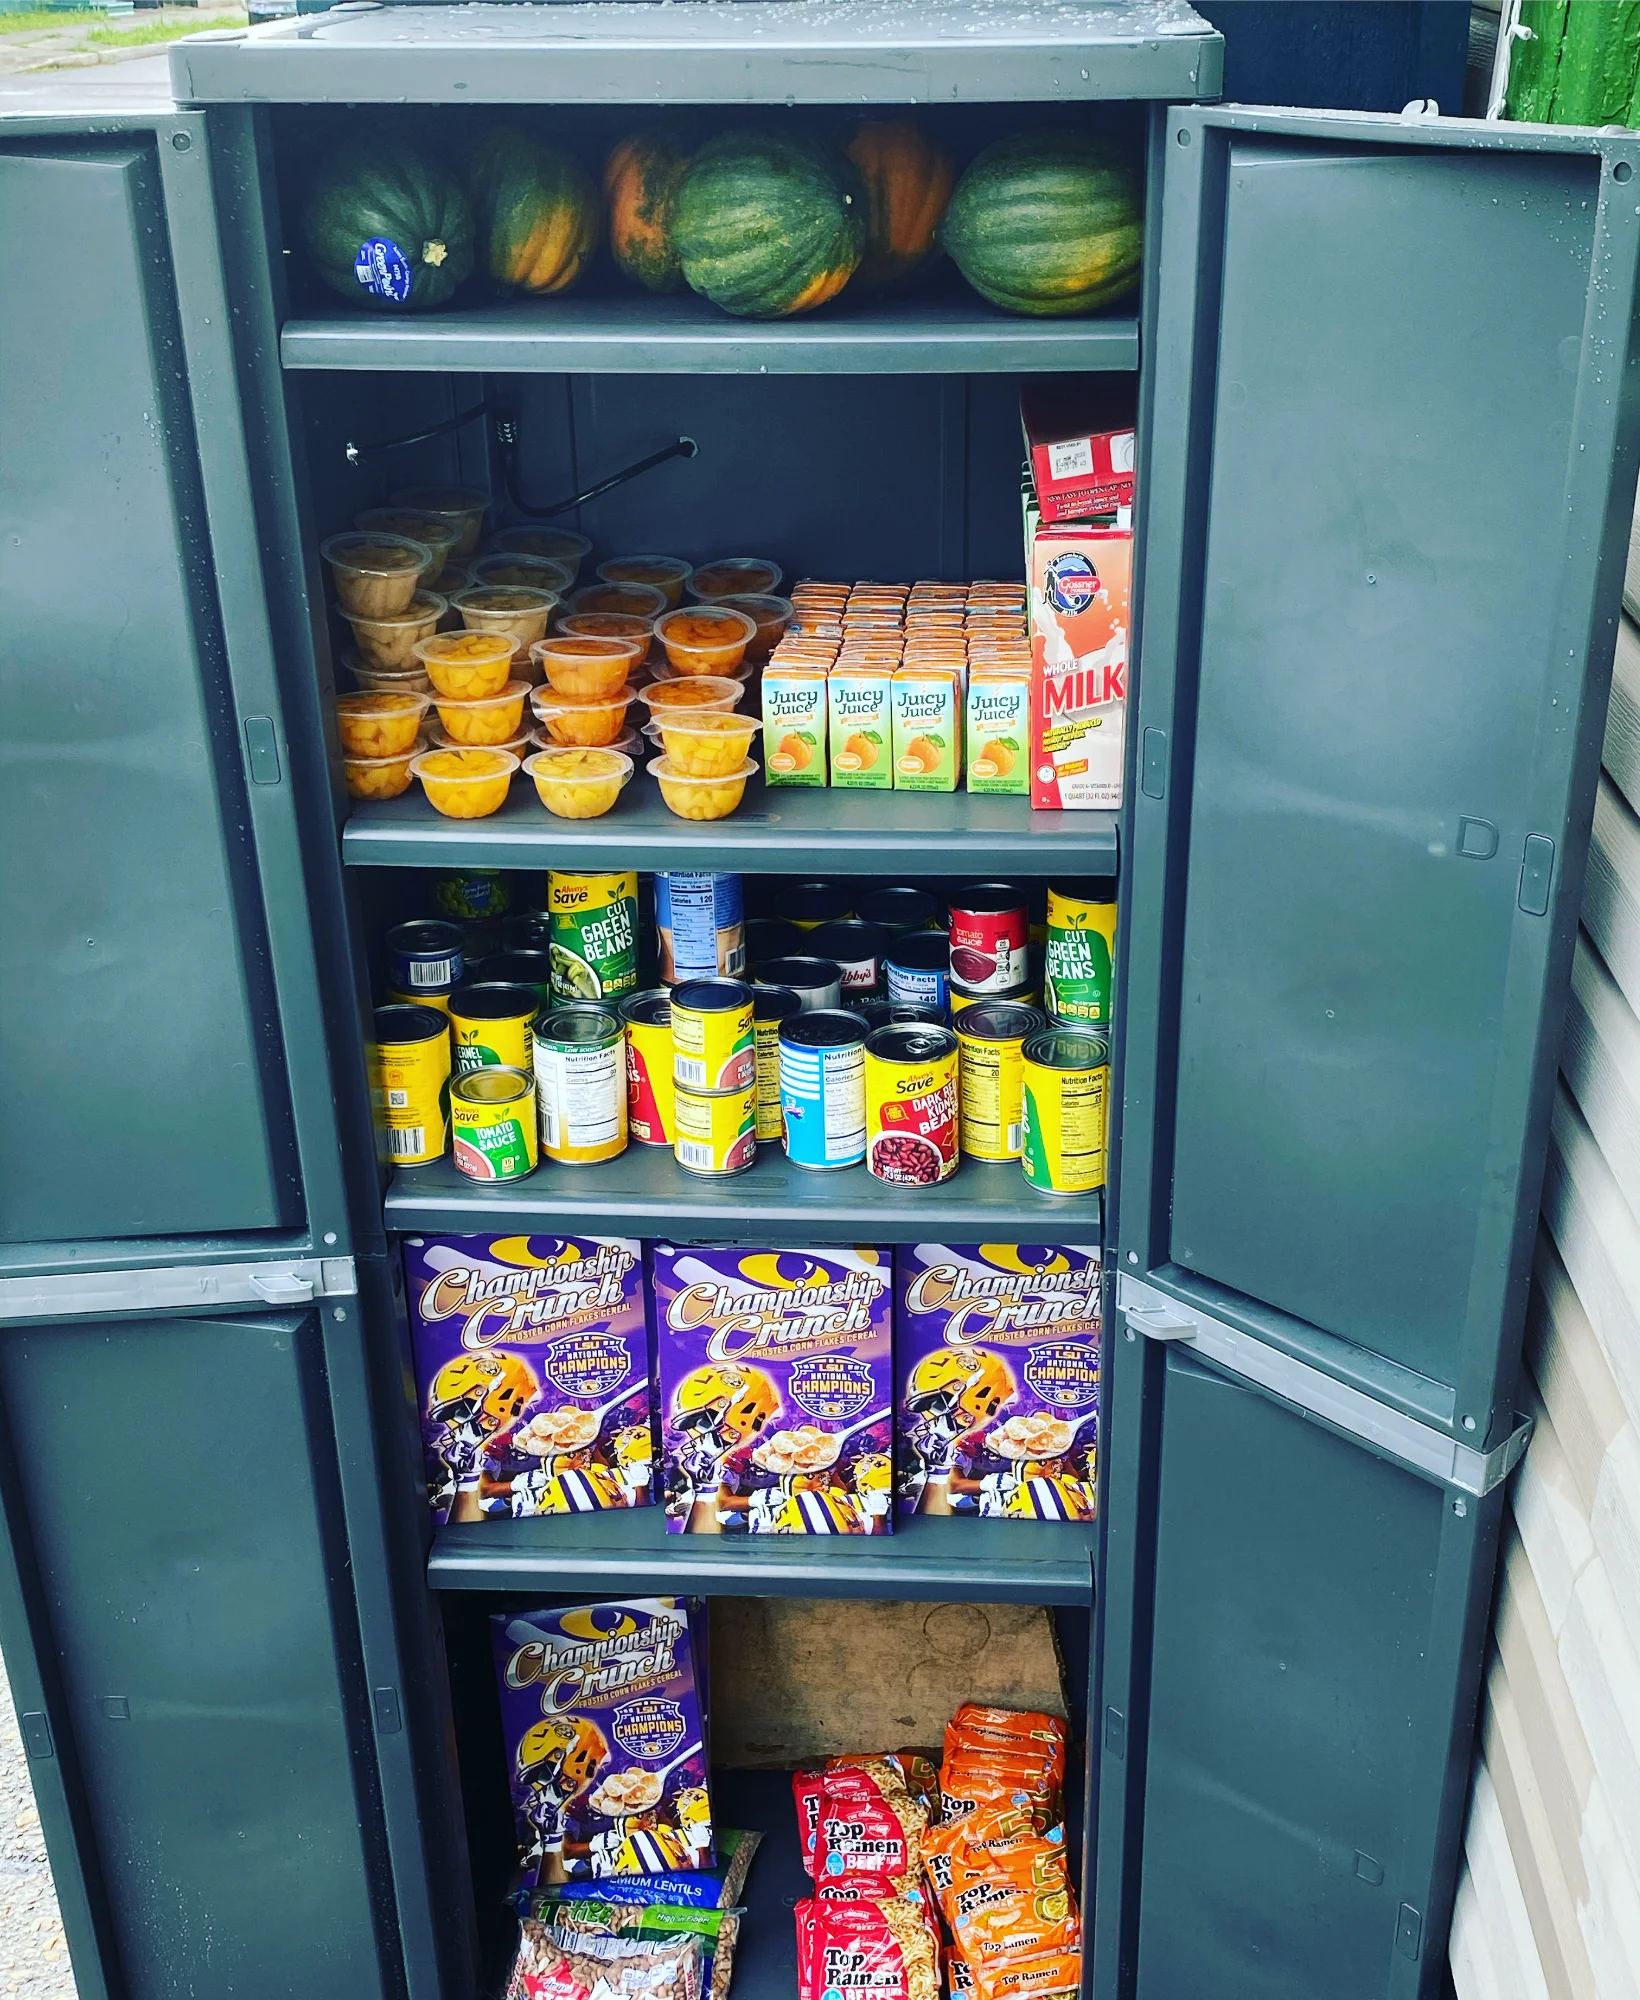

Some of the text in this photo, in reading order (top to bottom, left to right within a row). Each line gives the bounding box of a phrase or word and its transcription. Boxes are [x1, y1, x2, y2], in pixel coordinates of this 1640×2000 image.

[1104, 485, 1117, 493] CAP
[1060, 577, 1097, 593] Gossner
[1042, 658, 1079, 677] WHOLE
[835, 690, 884, 704] Juicy
[1042, 661, 1126, 718] MILK
[768, 690, 818, 705] Juicy
[897, 693, 947, 708] Juicy
[971, 695, 1020, 710] Juicy
[772, 702, 814, 715] Juice
[838, 702, 878, 714] Juice
[901, 705, 941, 718] Juice
[974, 707, 1015, 721] Juice
[1042, 718, 1102, 739] NATURALLY PRODUCED
[554, 889, 588, 904] Save
[561, 885, 588, 894] Always
[671, 895, 713, 904] Calories 120
[606, 899, 627, 917] CUT
[581, 911, 631, 943] GREEN
[956, 927, 983, 939] tomato
[957, 936, 982, 947] sauce
[1065, 930, 1087, 943] CUT
[583, 929, 633, 962] BEANS
[1048, 940, 1092, 961] GREEN
[1049, 958, 1096, 980] BEANS
[911, 975, 936, 983] Facts
[756, 1029, 778, 1037] Nutritio
[455, 1046, 483, 1059] ERNEL
[599, 1049, 615, 1059] Facts
[824, 1048, 862, 1061] Nutrition
[962, 1041, 1000, 1056] Nutrition Facts
[825, 1074, 854, 1083] Calories
[907, 1071, 933, 1083] Always
[1061, 1073, 1103, 1085] Nutrition Facts
[896, 1077, 934, 1094] Save
[912, 1091, 941, 1112] DARK
[454, 1108, 479, 1122] Save
[474, 1121, 514, 1140] TOMATO
[479, 1133, 516, 1151] SAUCE
[895, 1172, 902, 1180] OZ
[420, 1246, 634, 1321] Championship
[906, 1260, 1100, 1314] Championsh
[667, 1271, 883, 1330] Championship
[461, 1272, 624, 1350] Crunch
[943, 1287, 1100, 1345] Crunch
[507, 1303, 632, 1344] FROSTED CORN FLAKES CEREAL
[705, 1298, 872, 1362] Crunch
[989, 1324, 1082, 1343] FROSTED CORN FLAKES
[575, 1341, 599, 1350] LSU
[752, 1330, 878, 1358] FROSTED CORN FLAKES CEREAL
[567, 1350, 608, 1360] NATIONAL
[1055, 1351, 1081, 1359] LSU
[550, 1357, 627, 1376] CHAMPIONS
[819, 1364, 844, 1372] LSU
[1047, 1360, 1088, 1369] NATIONAL
[810, 1372, 852, 1380] NATIONAL
[1029, 1367, 1101, 1382] CHAMPION
[793, 1380, 870, 1394] CHAMPIONS
[504, 1615, 682, 1690] Championship
[540, 1642, 676, 1716] Crunch
[577, 1671, 683, 1708] FROSTED CORN FLAKES CEREAL
[636, 1705, 658, 1714] LSU
[630, 1714, 666, 1723] NATIONAL
[617, 1720, 682, 1738] CHAMPIONS
[825, 1781, 861, 1793] THE ORIGINAL
[942, 1793, 976, 1813] Top
[847, 1811, 884, 1822] THE ORIGINAL
[825, 1820, 864, 1840] Top
[828, 1837, 900, 1854] Ramen
[846, 1853, 886, 1871] BEEF
[929, 1854, 951, 1872] To
[607, 1876, 702, 1897] EMIUM LENTILS
[852, 1878, 879, 1887] ORIGINAL
[820, 1888, 858, 1900] Top
[956, 1883, 992, 1901] Top
[657, 1913, 677, 1923] High
[686, 1915, 710, 1925] Fiber!
[831, 1911, 869, 1921] THE ORIGINAL
[984, 1941, 1001, 1952] Top
[826, 1948, 865, 1972] Top
[826, 1968, 900, 1986] Ramen
[1002, 1968, 1058, 1986] Top Ramen
